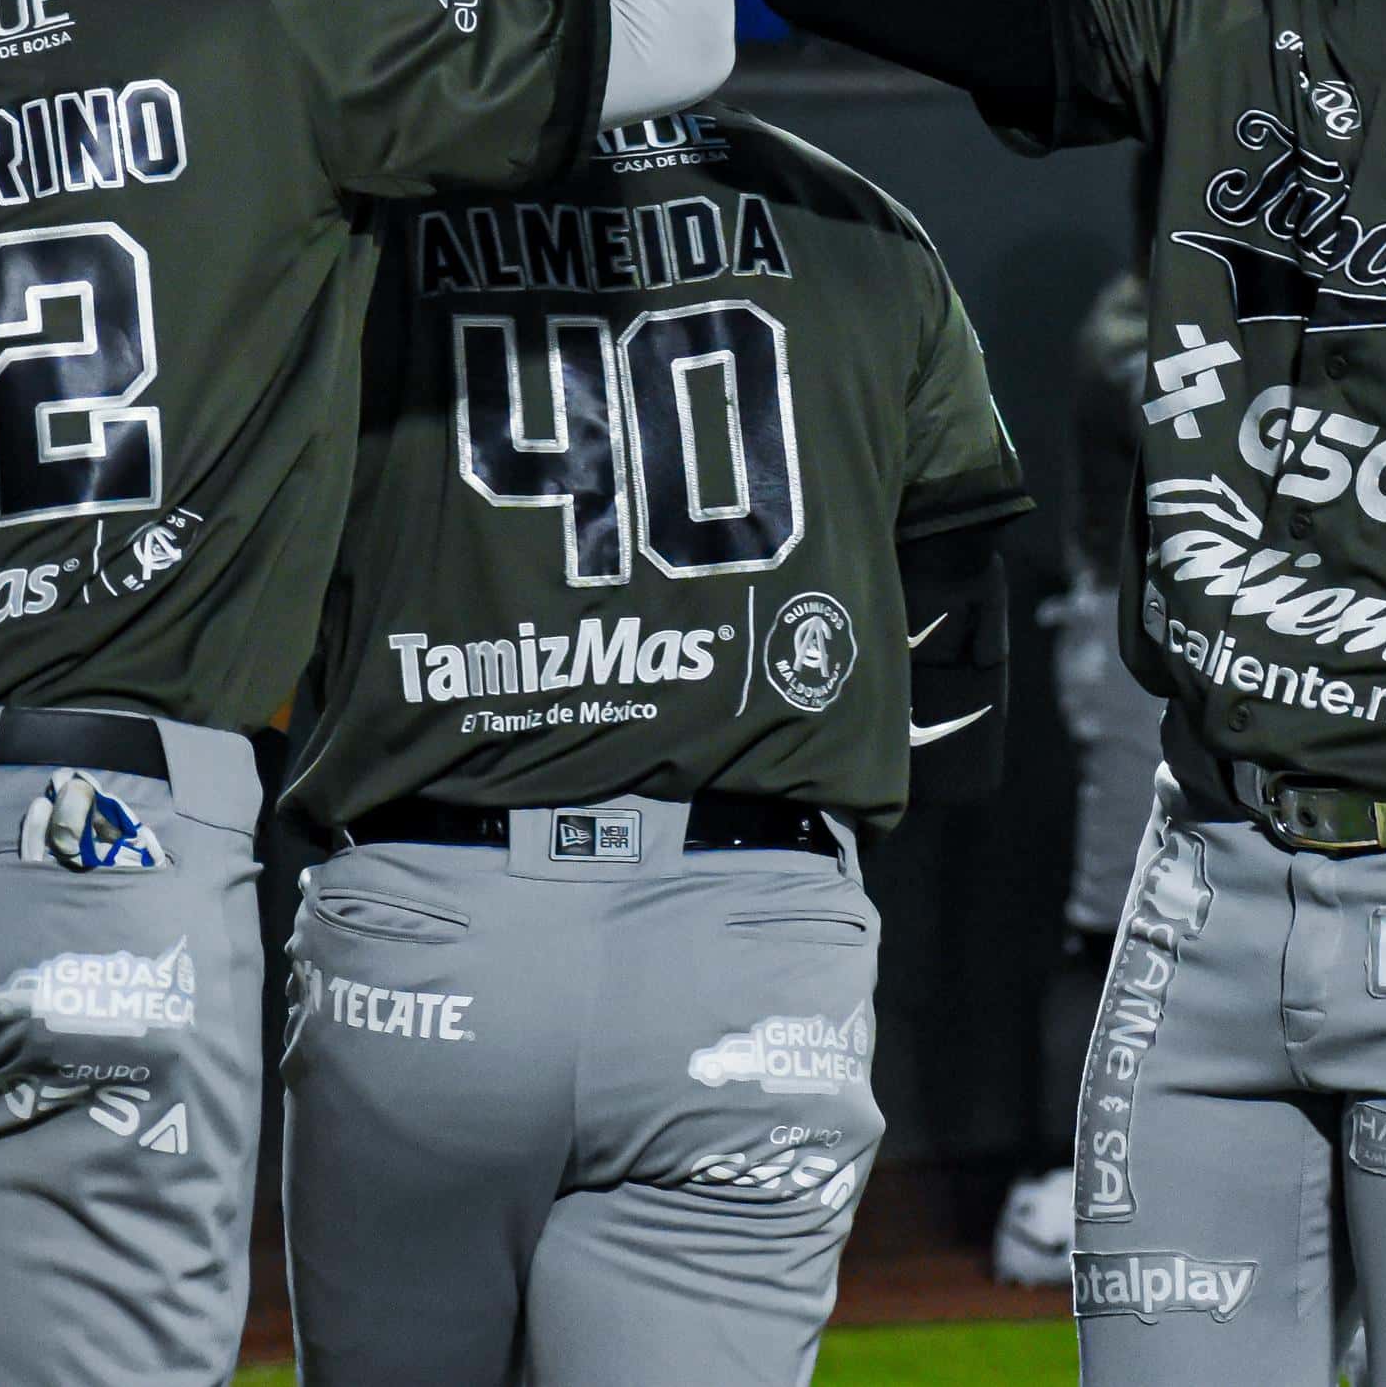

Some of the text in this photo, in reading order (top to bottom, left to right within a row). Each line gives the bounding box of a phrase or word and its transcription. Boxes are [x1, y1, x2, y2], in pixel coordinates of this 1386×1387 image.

[0, 43, 19, 60] DE
[24, 30, 73, 55] BOLSA
[417, 192, 793, 298] ALMEIDA
[452, 299, 806, 589] 40
[388, 616, 716, 705] TamizMas
[481, 709, 543, 734] Tamiz
[546, 703, 575, 726] de
[579, 701, 659, 726] México
[599, 825, 629, 839] NEW
[599, 838, 629, 851] ERA
[53, 988, 196, 1026] OLMECA
[327, 975, 474, 1041] TECATE
[60, 1064, 152, 1082] GRUPO
[765, 1049, 864, 1086] OLMECA
[1074, 1258, 1254, 1316] otalplay
